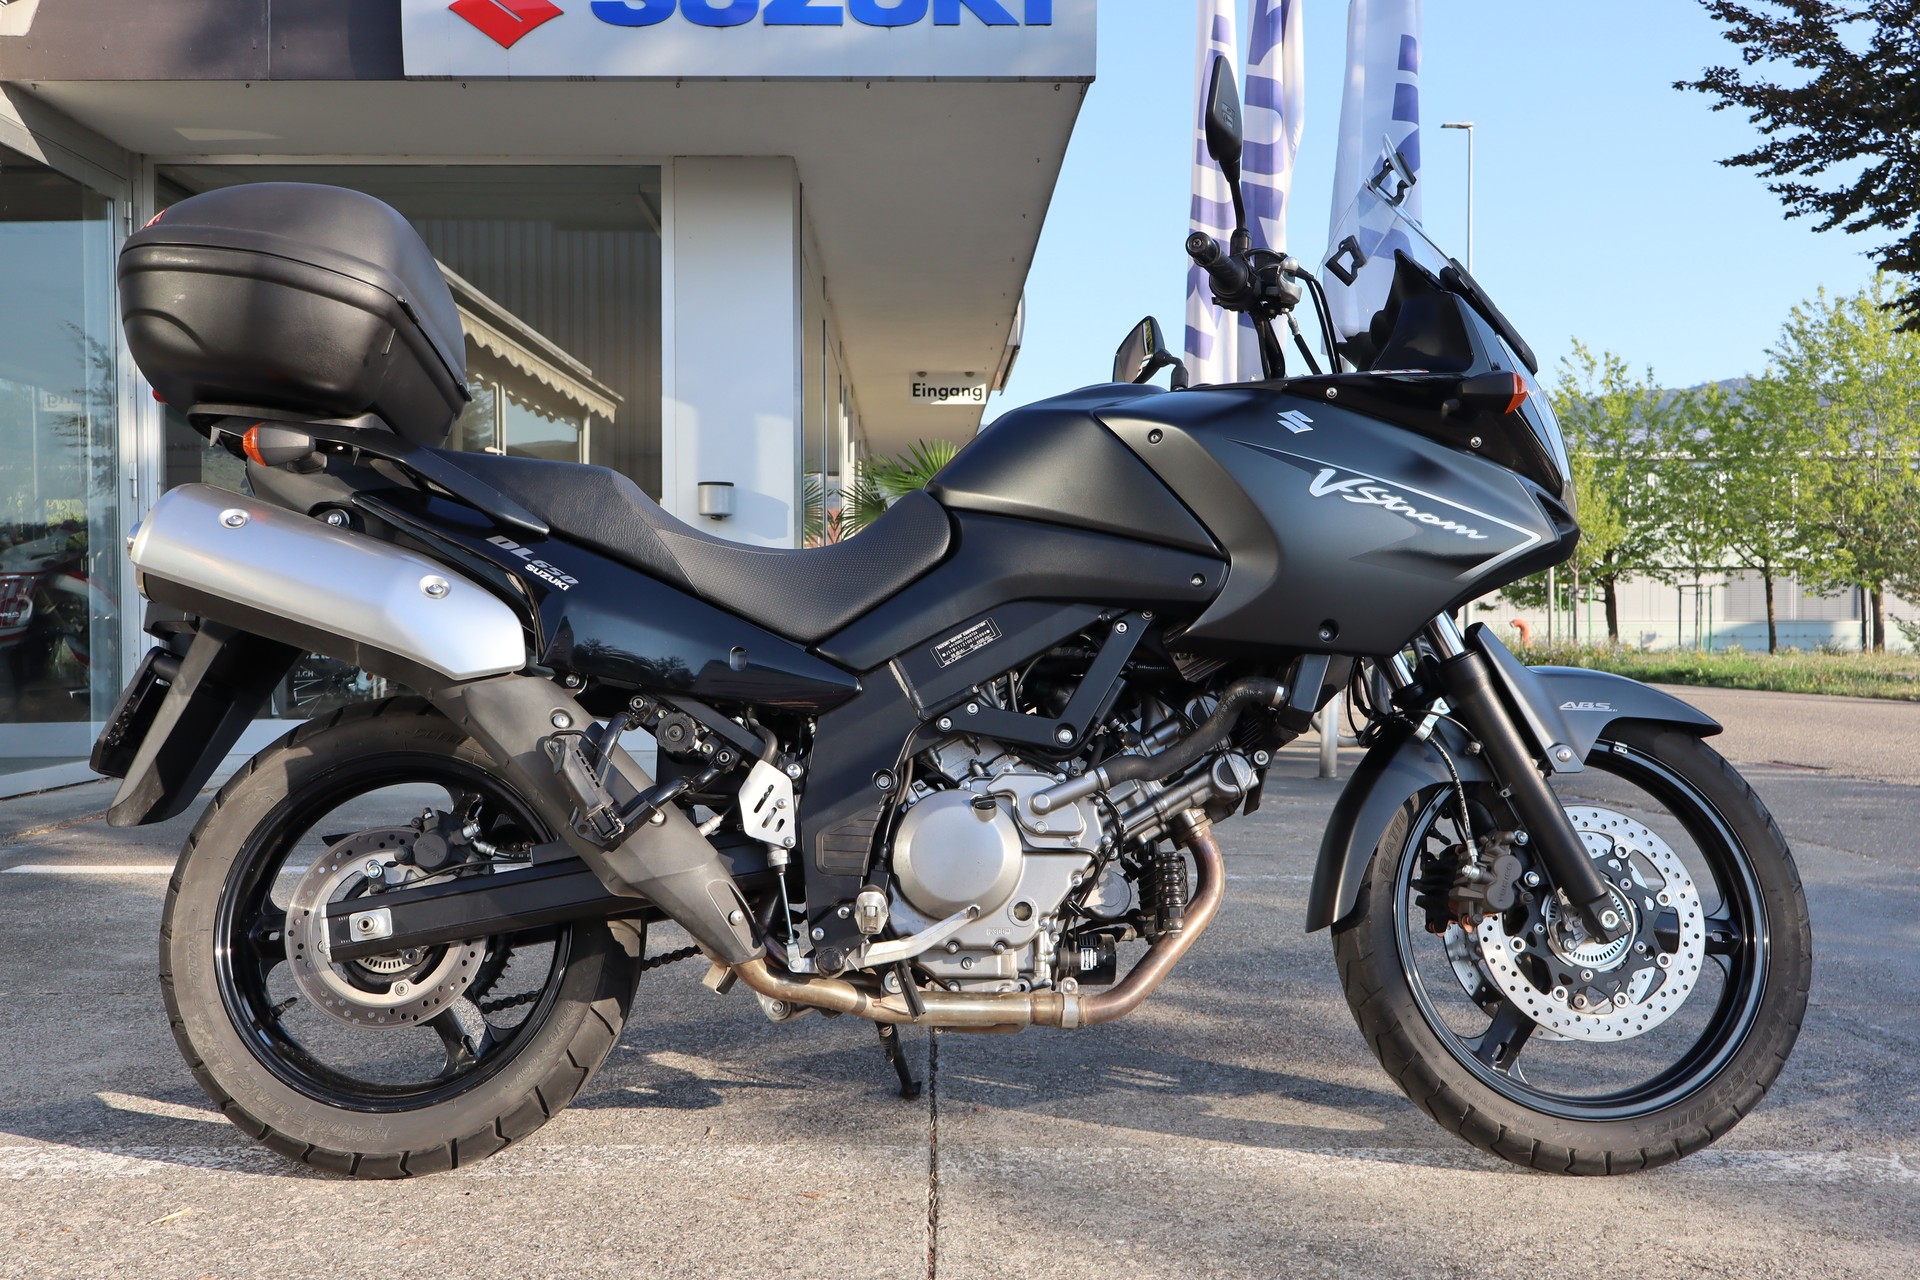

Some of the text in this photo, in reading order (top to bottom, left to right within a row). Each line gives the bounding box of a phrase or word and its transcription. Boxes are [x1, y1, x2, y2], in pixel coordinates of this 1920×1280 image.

[912, 383, 983, 401] Eingang
[524, 563, 570, 591] SUZUKI
[1559, 701, 1612, 711] ABS
